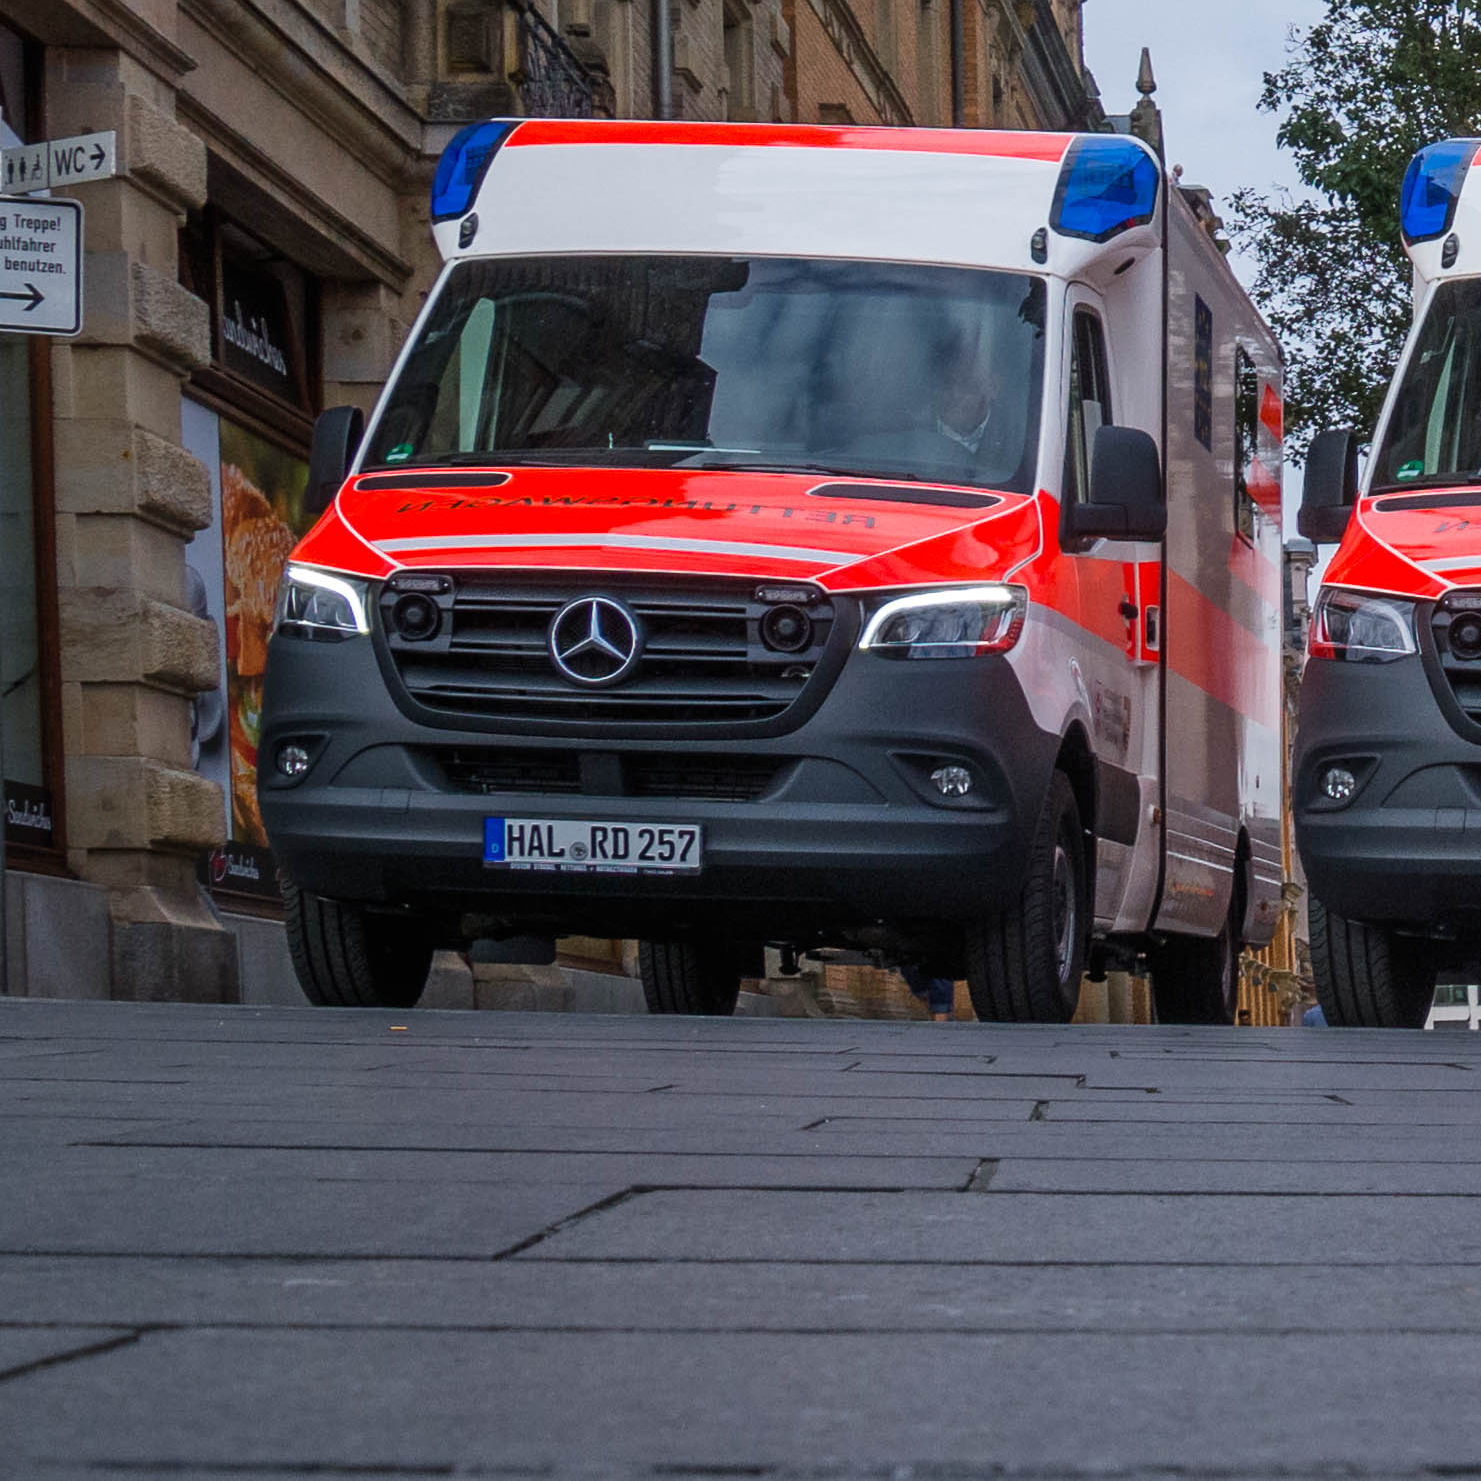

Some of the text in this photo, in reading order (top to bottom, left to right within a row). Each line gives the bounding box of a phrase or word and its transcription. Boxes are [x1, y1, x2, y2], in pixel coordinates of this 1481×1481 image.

[55, 146, 85, 176] WC
[14, 214, 61, 233] Treppe!
[5, 256, 66, 274] benutzen.
[491, 824, 697, 863] D HAL RD 257
